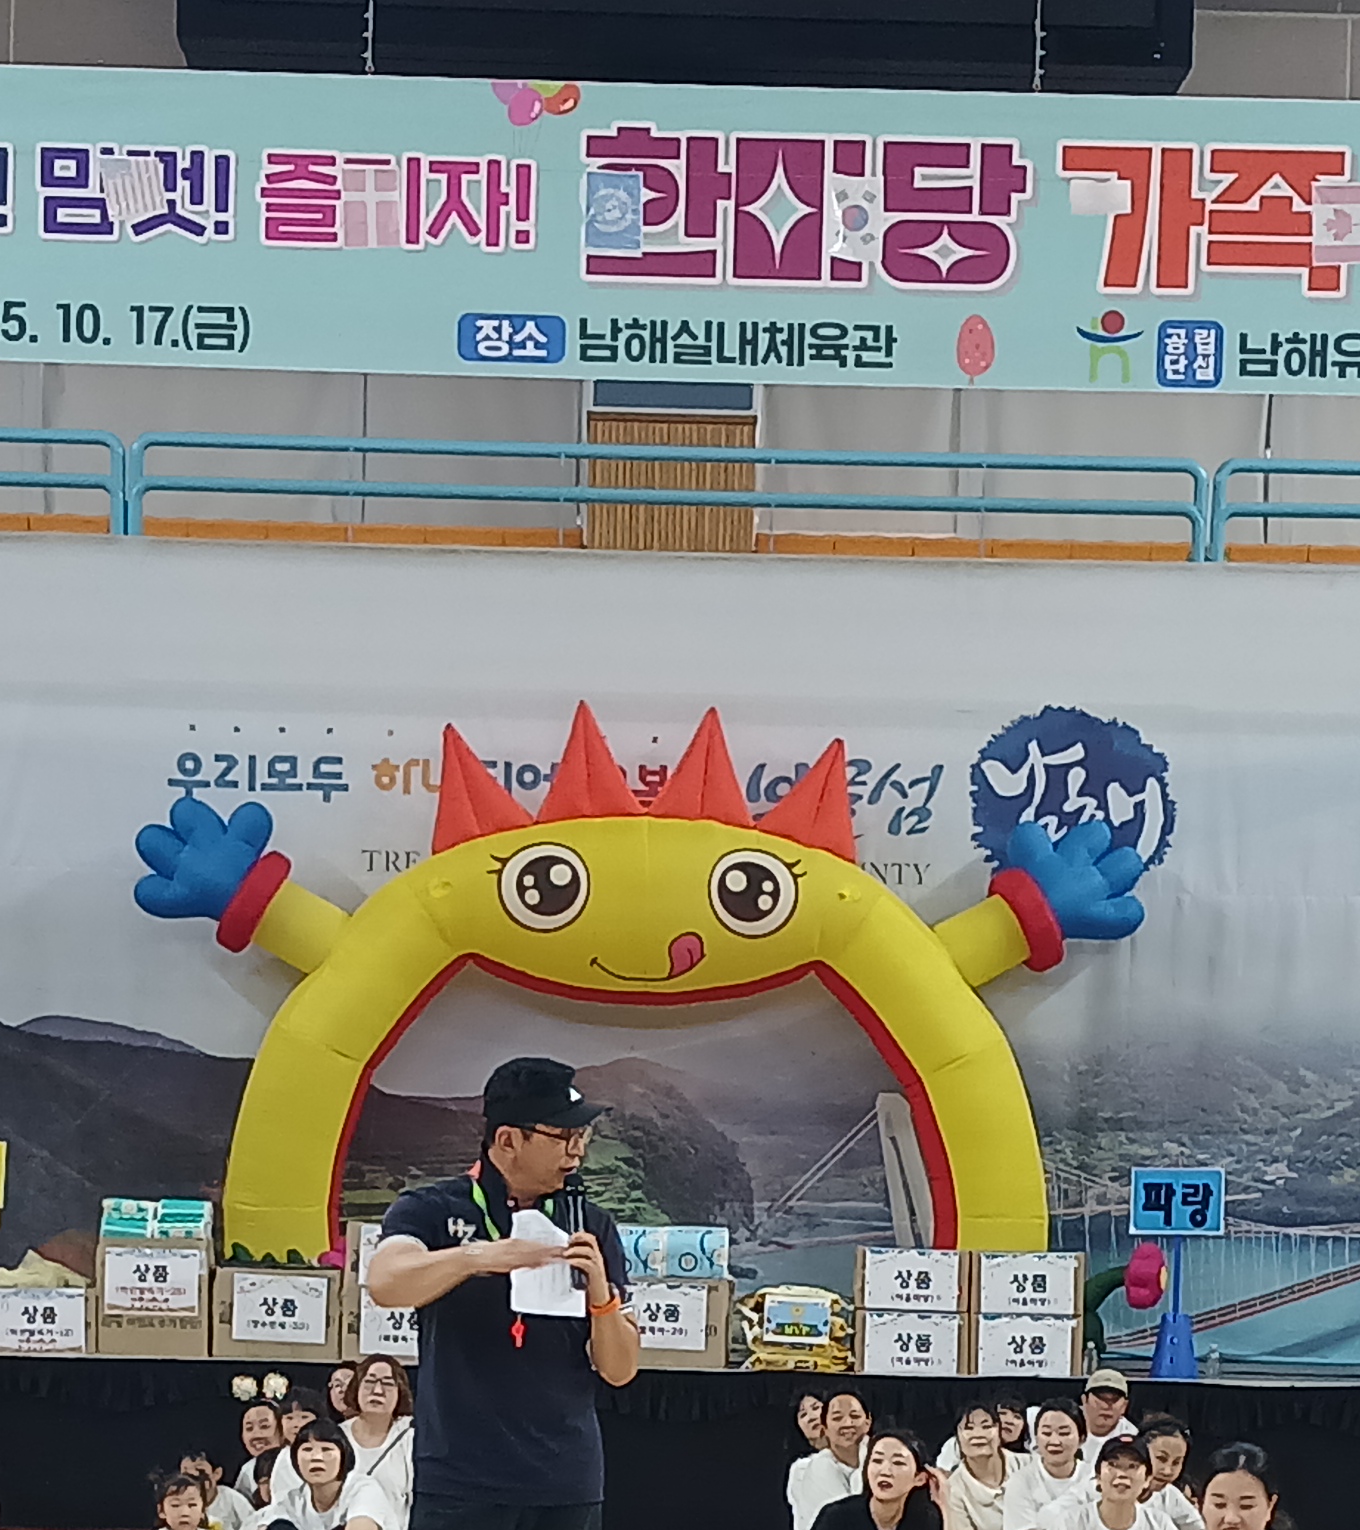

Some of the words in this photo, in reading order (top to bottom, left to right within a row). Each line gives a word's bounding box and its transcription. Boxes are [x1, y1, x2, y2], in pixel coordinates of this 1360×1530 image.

[1061, 145, 1347, 292] 가족
[55, 302, 113, 347] 10.
[128, 303, 251, 354] 17.(금)
[474, 317, 549, 359] 장소
[577, 316, 899, 370] 남해실내체육관
[1162, 327, 1217, 355] 공립
[1161, 355, 1217, 382] 단설
[167, 752, 350, 804] 우리모두
[1142, 1182, 1214, 1229] 파랑
[131, 1263, 170, 1284] 상품
[893, 1269, 933, 1290] 상품
[1009, 1273, 1048, 1294] 상품
[20, 1305, 58, 1326] 상품
[258, 1296, 299, 1318] 상품
[642, 1302, 681, 1324] 상품
[893, 1332, 933, 1354] 상품
[1007, 1335, 1047, 1355] 상품
